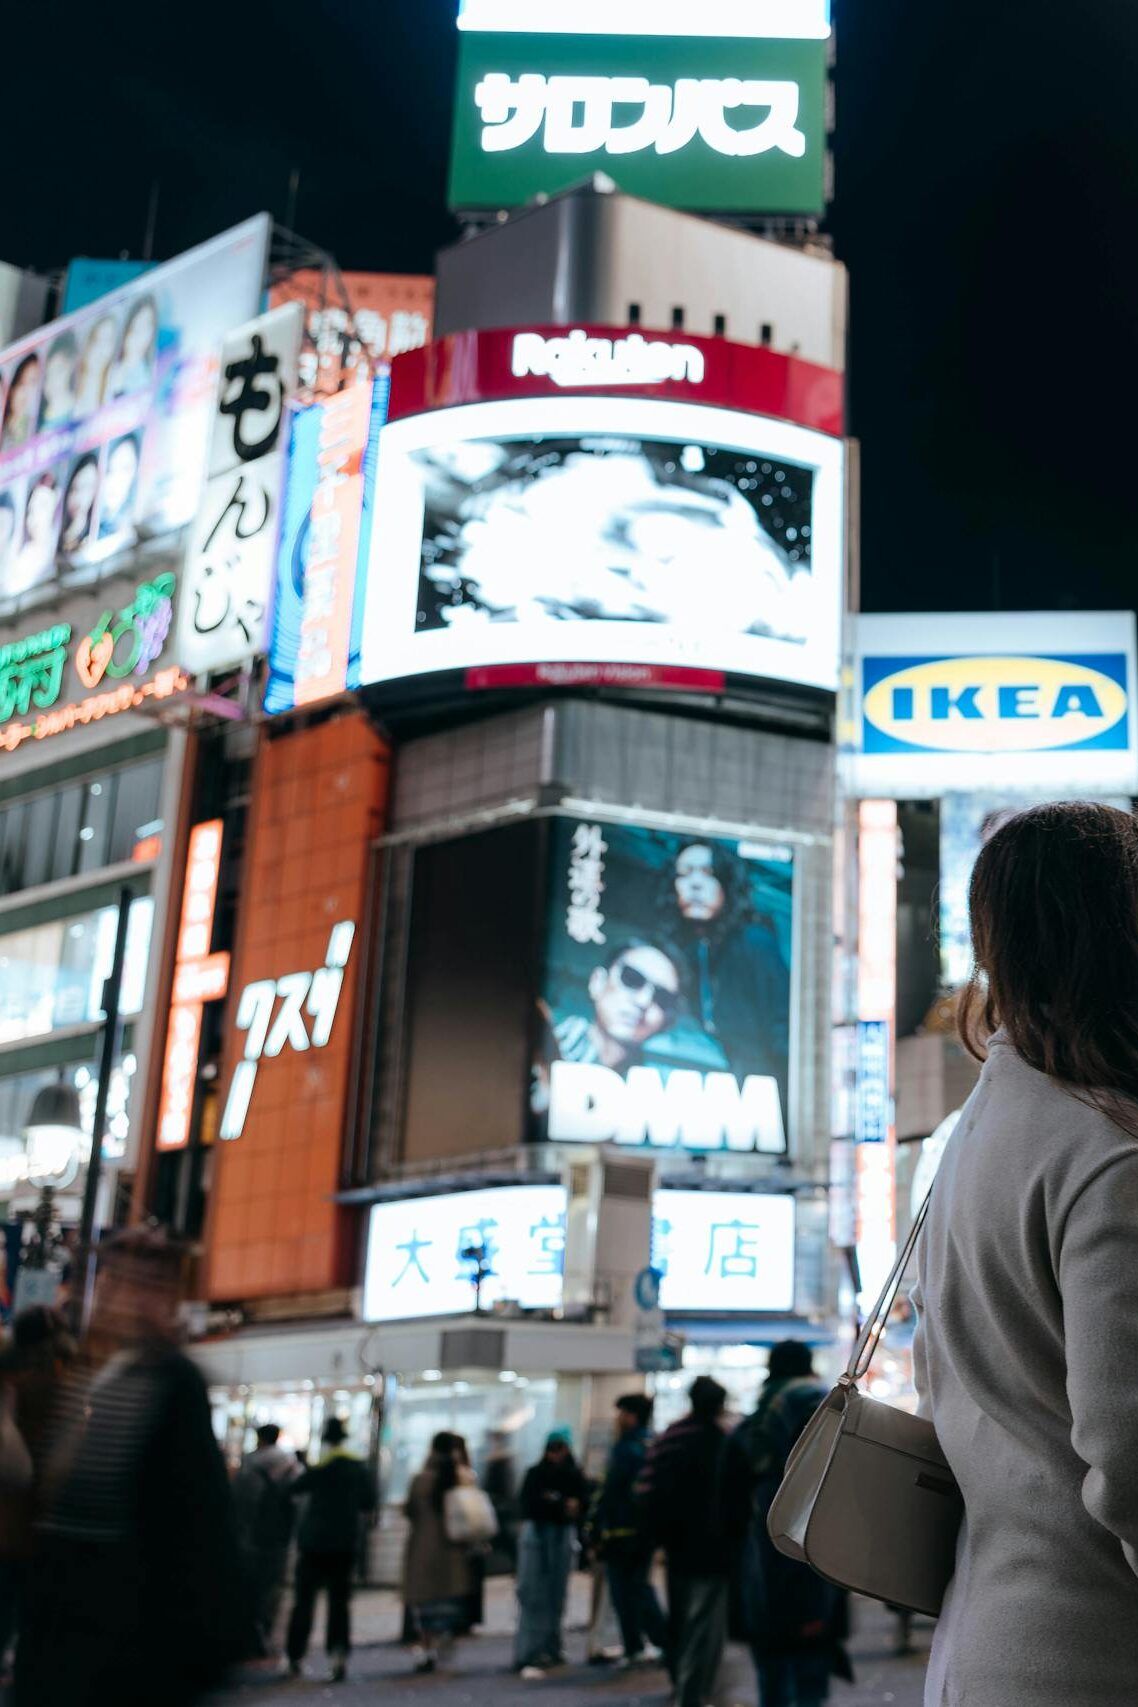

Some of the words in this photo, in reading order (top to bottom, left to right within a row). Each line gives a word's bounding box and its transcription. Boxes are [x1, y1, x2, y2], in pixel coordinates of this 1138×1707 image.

[475, 72, 806, 157] サロンパス
[511, 329, 705, 387] Rakuten
[193, 334, 285, 644] もんじゃ
[892, 684, 1105, 721] IKEA
[548, 1060, 786, 1154] DMM
